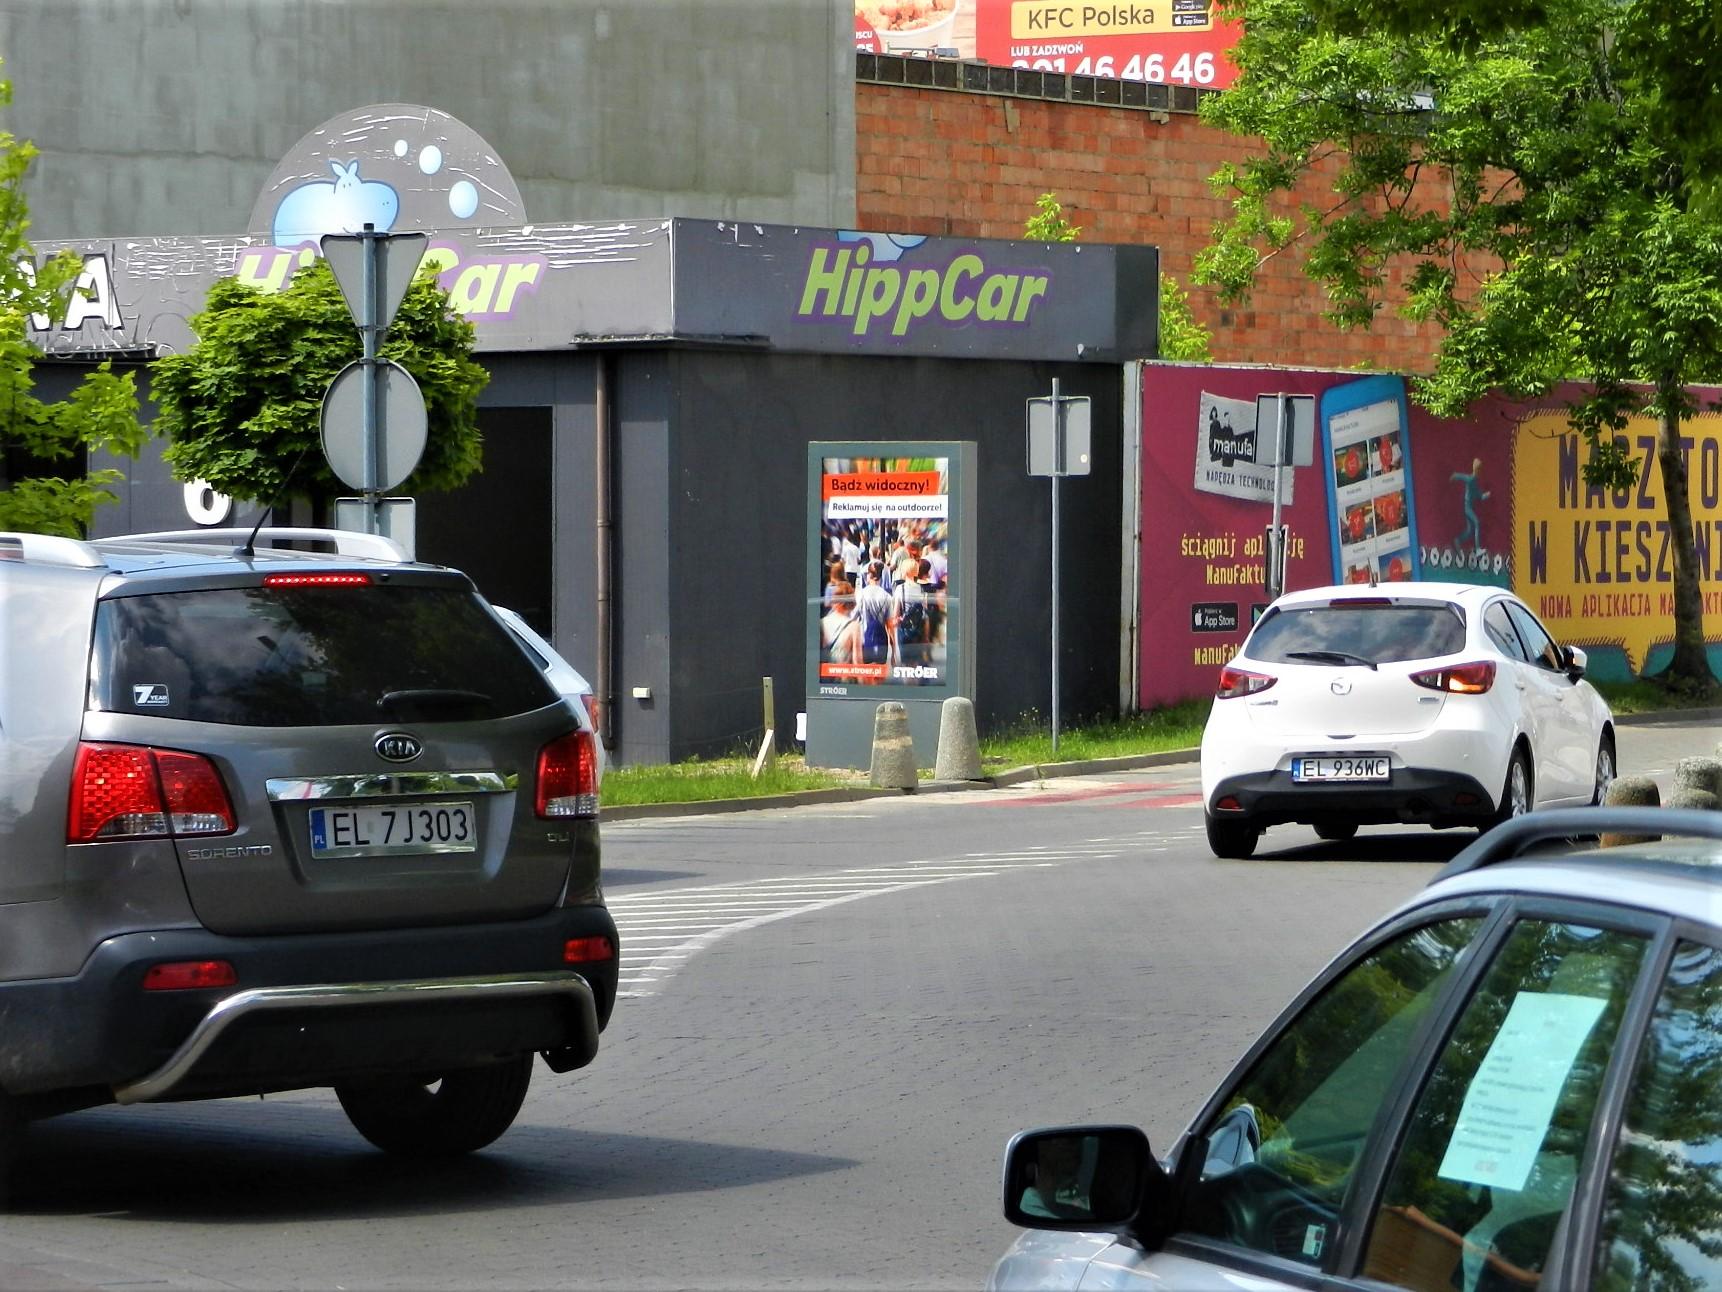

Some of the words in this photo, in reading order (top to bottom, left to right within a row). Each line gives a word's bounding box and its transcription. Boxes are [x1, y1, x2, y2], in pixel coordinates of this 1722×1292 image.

[1028, 8, 1074, 30] KFC
[1083, 4, 1155, 27] Polska
[1011, 46, 1031, 57] LUB
[1032, 41, 1084, 56] ZADZWOŃ
[1121, 53, 1165, 83] 46
[1170, 52, 1215, 84] 46
[798, 244, 1049, 337] HippCar
[1213, 438, 1254, 457] manufa
[865, 478, 930, 494] widoczny!
[832, 502, 870, 513] Reklamuj
[871, 503, 883, 513] się
[897, 502, 943, 512] outdoorze!
[1181, 532, 1236, 559] ściągnij
[1529, 520, 1547, 584] W
[1574, 520, 1722, 584] KIESZNI
[1540, 594, 1572, 619] NOWA
[1582, 592, 1651, 618] APLIKACJA
[1204, 615, 1218, 628] App
[1218, 614, 1236, 626] Store
[893, 665, 938, 679] STRÖER
[135, 685, 154, 704] 7
[384, 740, 416, 755] KIA
[1303, 760, 1326, 777] EL
[1333, 760, 1386, 777] 936WC
[333, 812, 370, 847] EL
[381, 808, 468, 844] 7J303
[314, 835, 325, 845] PL
[187, 845, 273, 860] SORENTO
